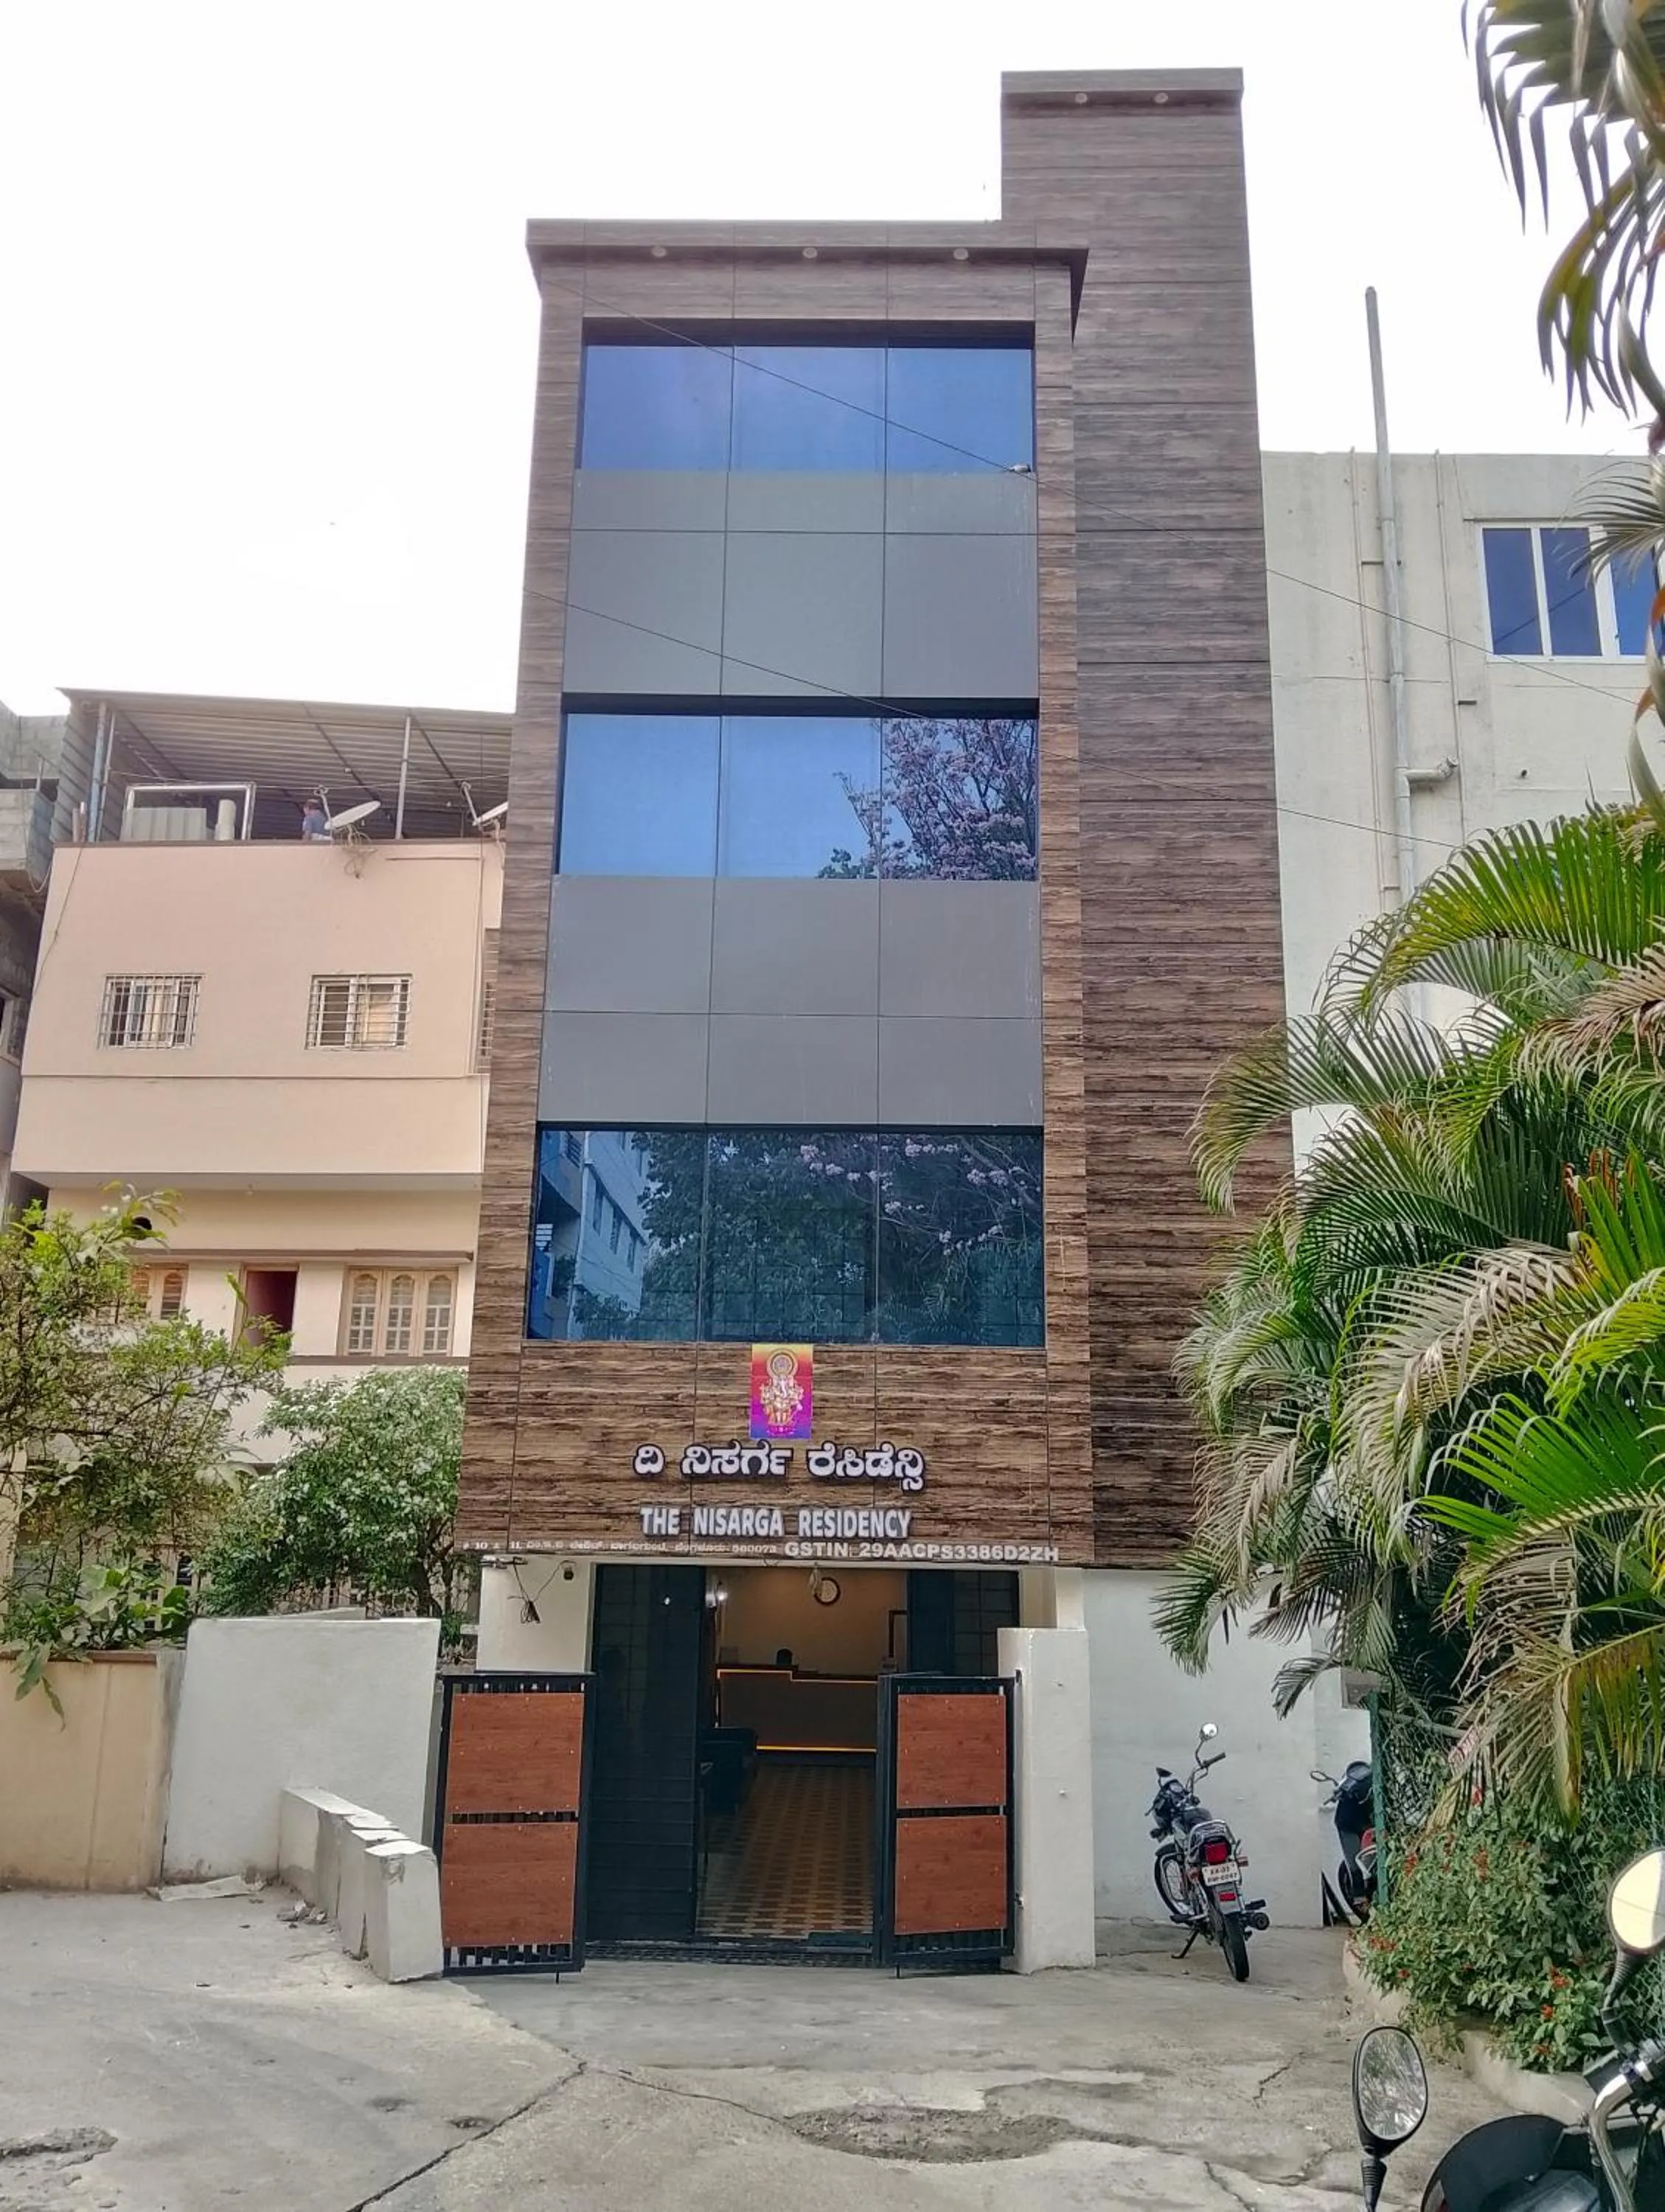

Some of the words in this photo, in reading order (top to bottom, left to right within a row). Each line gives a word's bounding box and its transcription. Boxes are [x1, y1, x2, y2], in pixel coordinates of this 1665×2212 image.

[633, 1444, 665, 1475] ದಿ
[681, 1439, 793, 1476] ನಿಸರ್ಗ
[807, 1440, 925, 1491] ರೆಸಿಡೆನ್ಸಿ
[640, 1507, 680, 1536] THE
[694, 1507, 782, 1537] NISARGA
[799, 1509, 911, 1538] RESIDENCY
